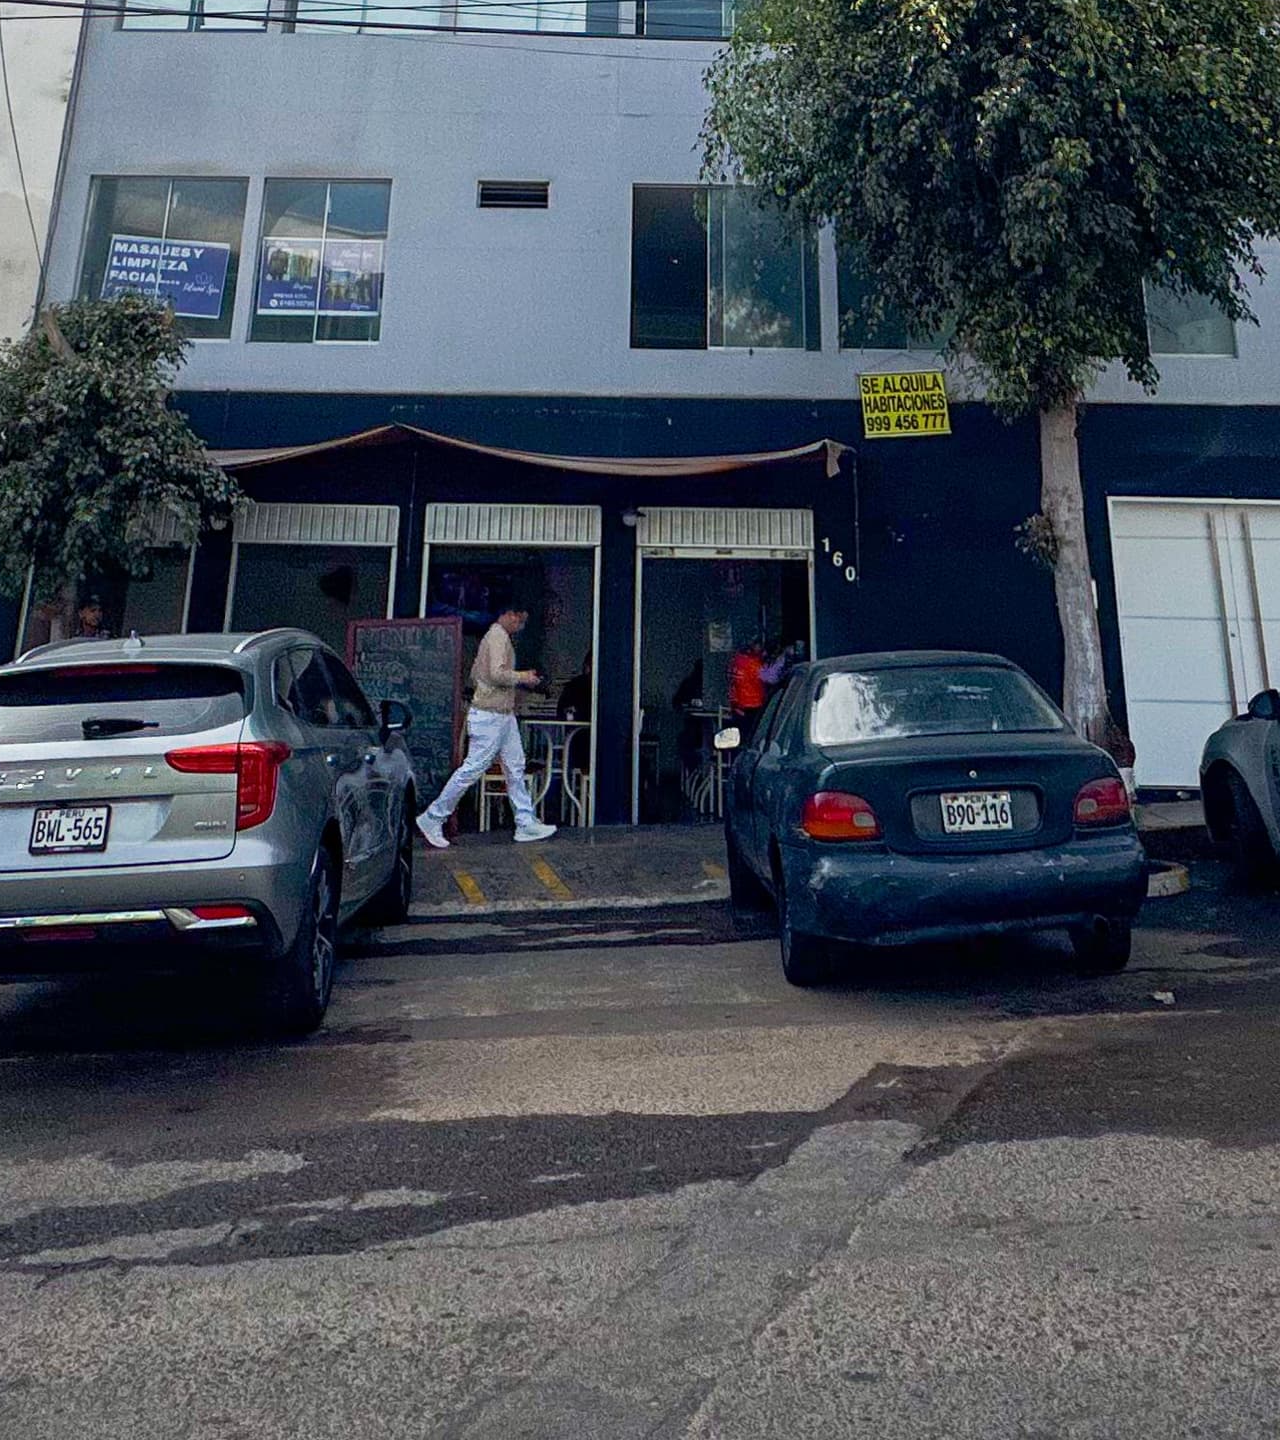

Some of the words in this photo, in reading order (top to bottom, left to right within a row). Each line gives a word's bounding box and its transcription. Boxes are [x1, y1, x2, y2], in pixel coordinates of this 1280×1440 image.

[114, 242, 191, 258] MASAJES
[193, 248, 205, 259] Y
[111, 256, 189, 272] LIMPIEZA
[862, 377, 880, 394] SE
[882, 374, 942, 393] ALQUILA
[864, 393, 946, 414] HABITACIONES
[866, 415, 891, 432] 999
[895, 414, 919, 431] 456
[922, 412, 946, 429] 777
[947, 802, 1009, 826] B90-116
[35, 817, 104, 843] BWL-565
